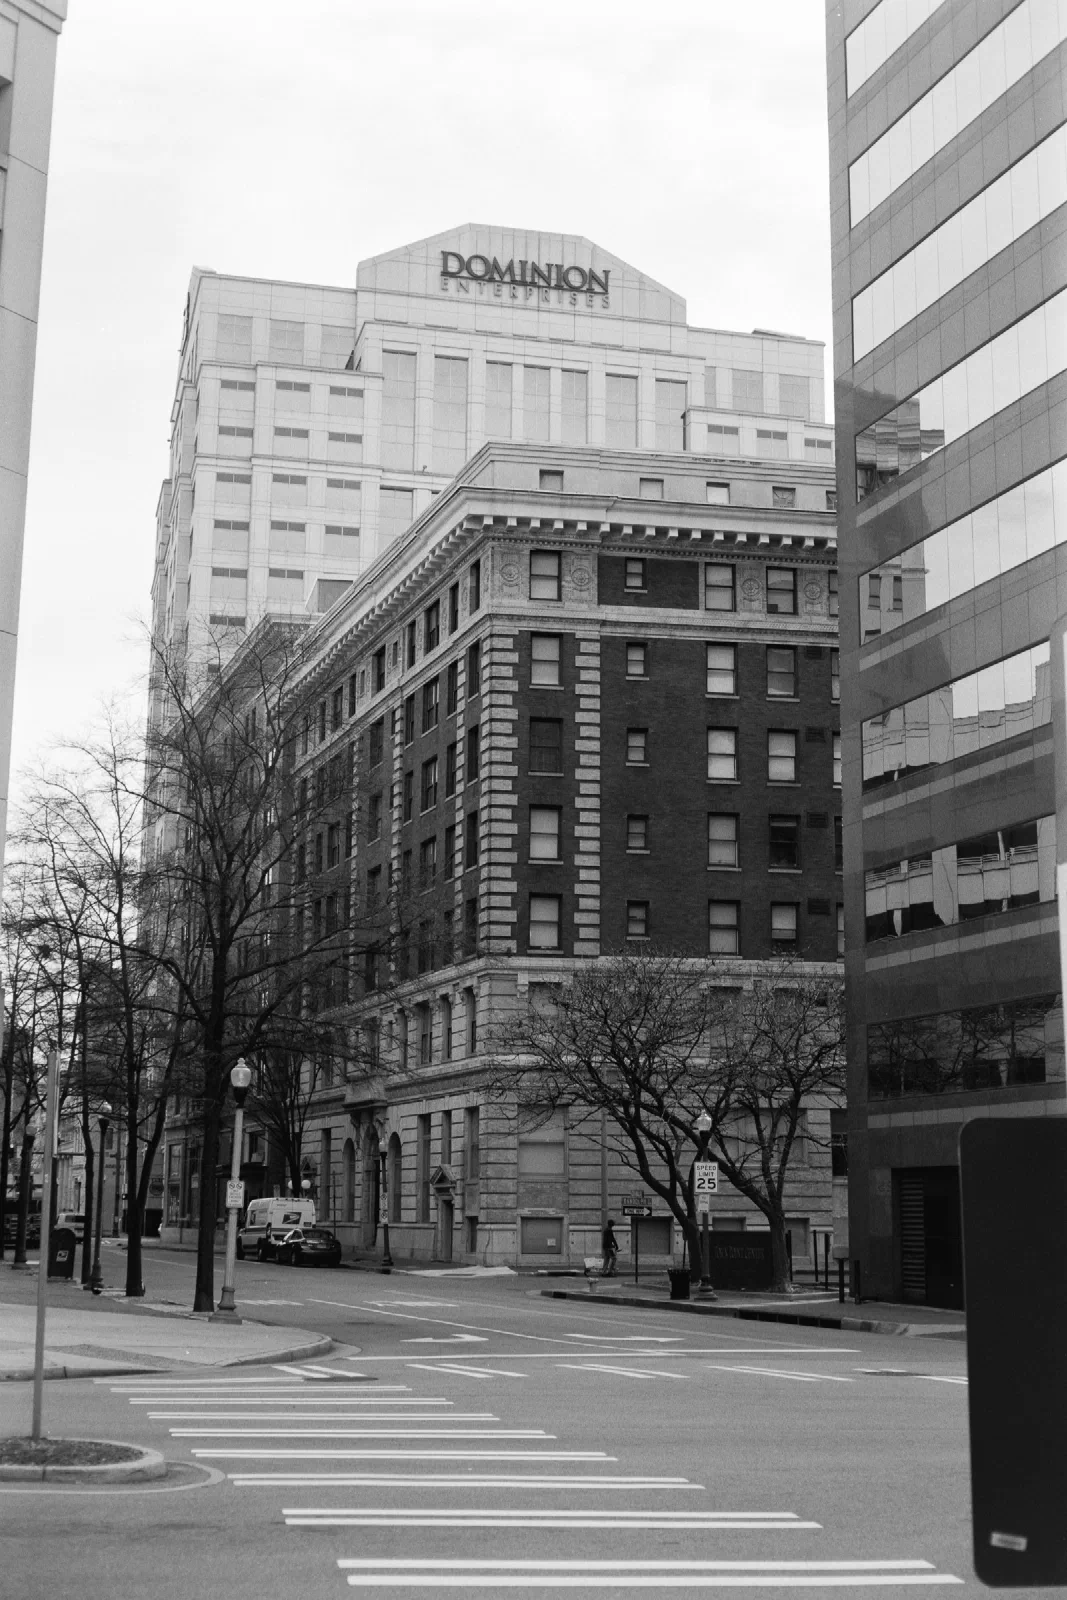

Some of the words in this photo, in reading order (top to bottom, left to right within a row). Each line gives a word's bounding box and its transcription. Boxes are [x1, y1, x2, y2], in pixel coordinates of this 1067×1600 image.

[441, 250, 611, 294] DOMINION
[441, 278, 610, 309] ENTERPRISES
[697, 1177, 717, 1190] 25
